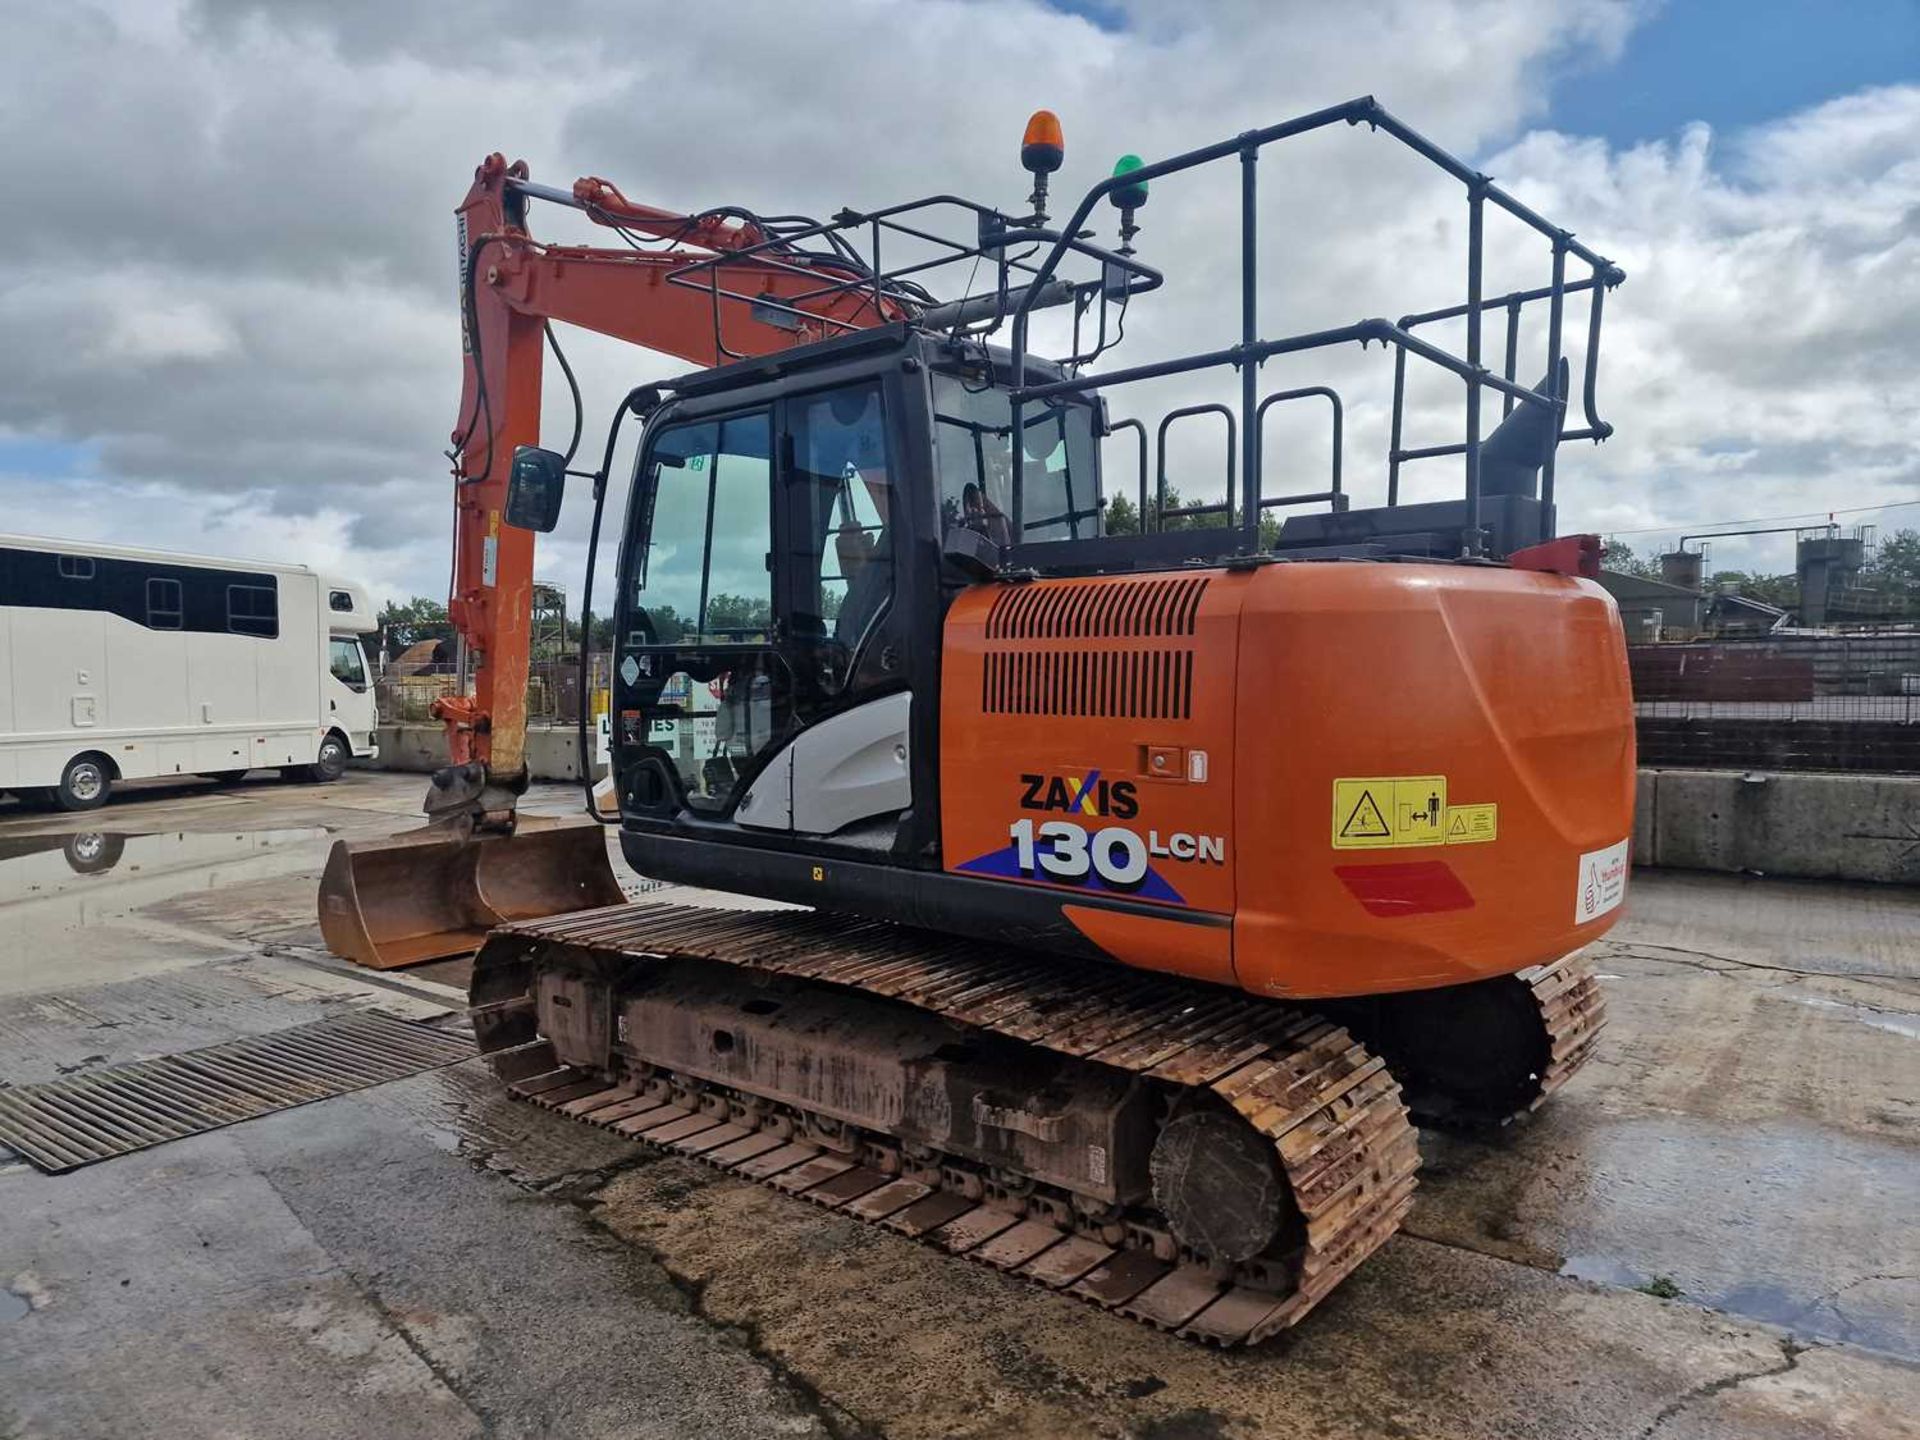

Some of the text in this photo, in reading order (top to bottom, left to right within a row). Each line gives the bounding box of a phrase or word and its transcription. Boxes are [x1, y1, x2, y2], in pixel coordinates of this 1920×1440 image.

[458, 217, 469, 284] HITACHI
[1020, 769, 1139, 819] ZAXIS
[1009, 818, 1224, 891] 130 LCN
